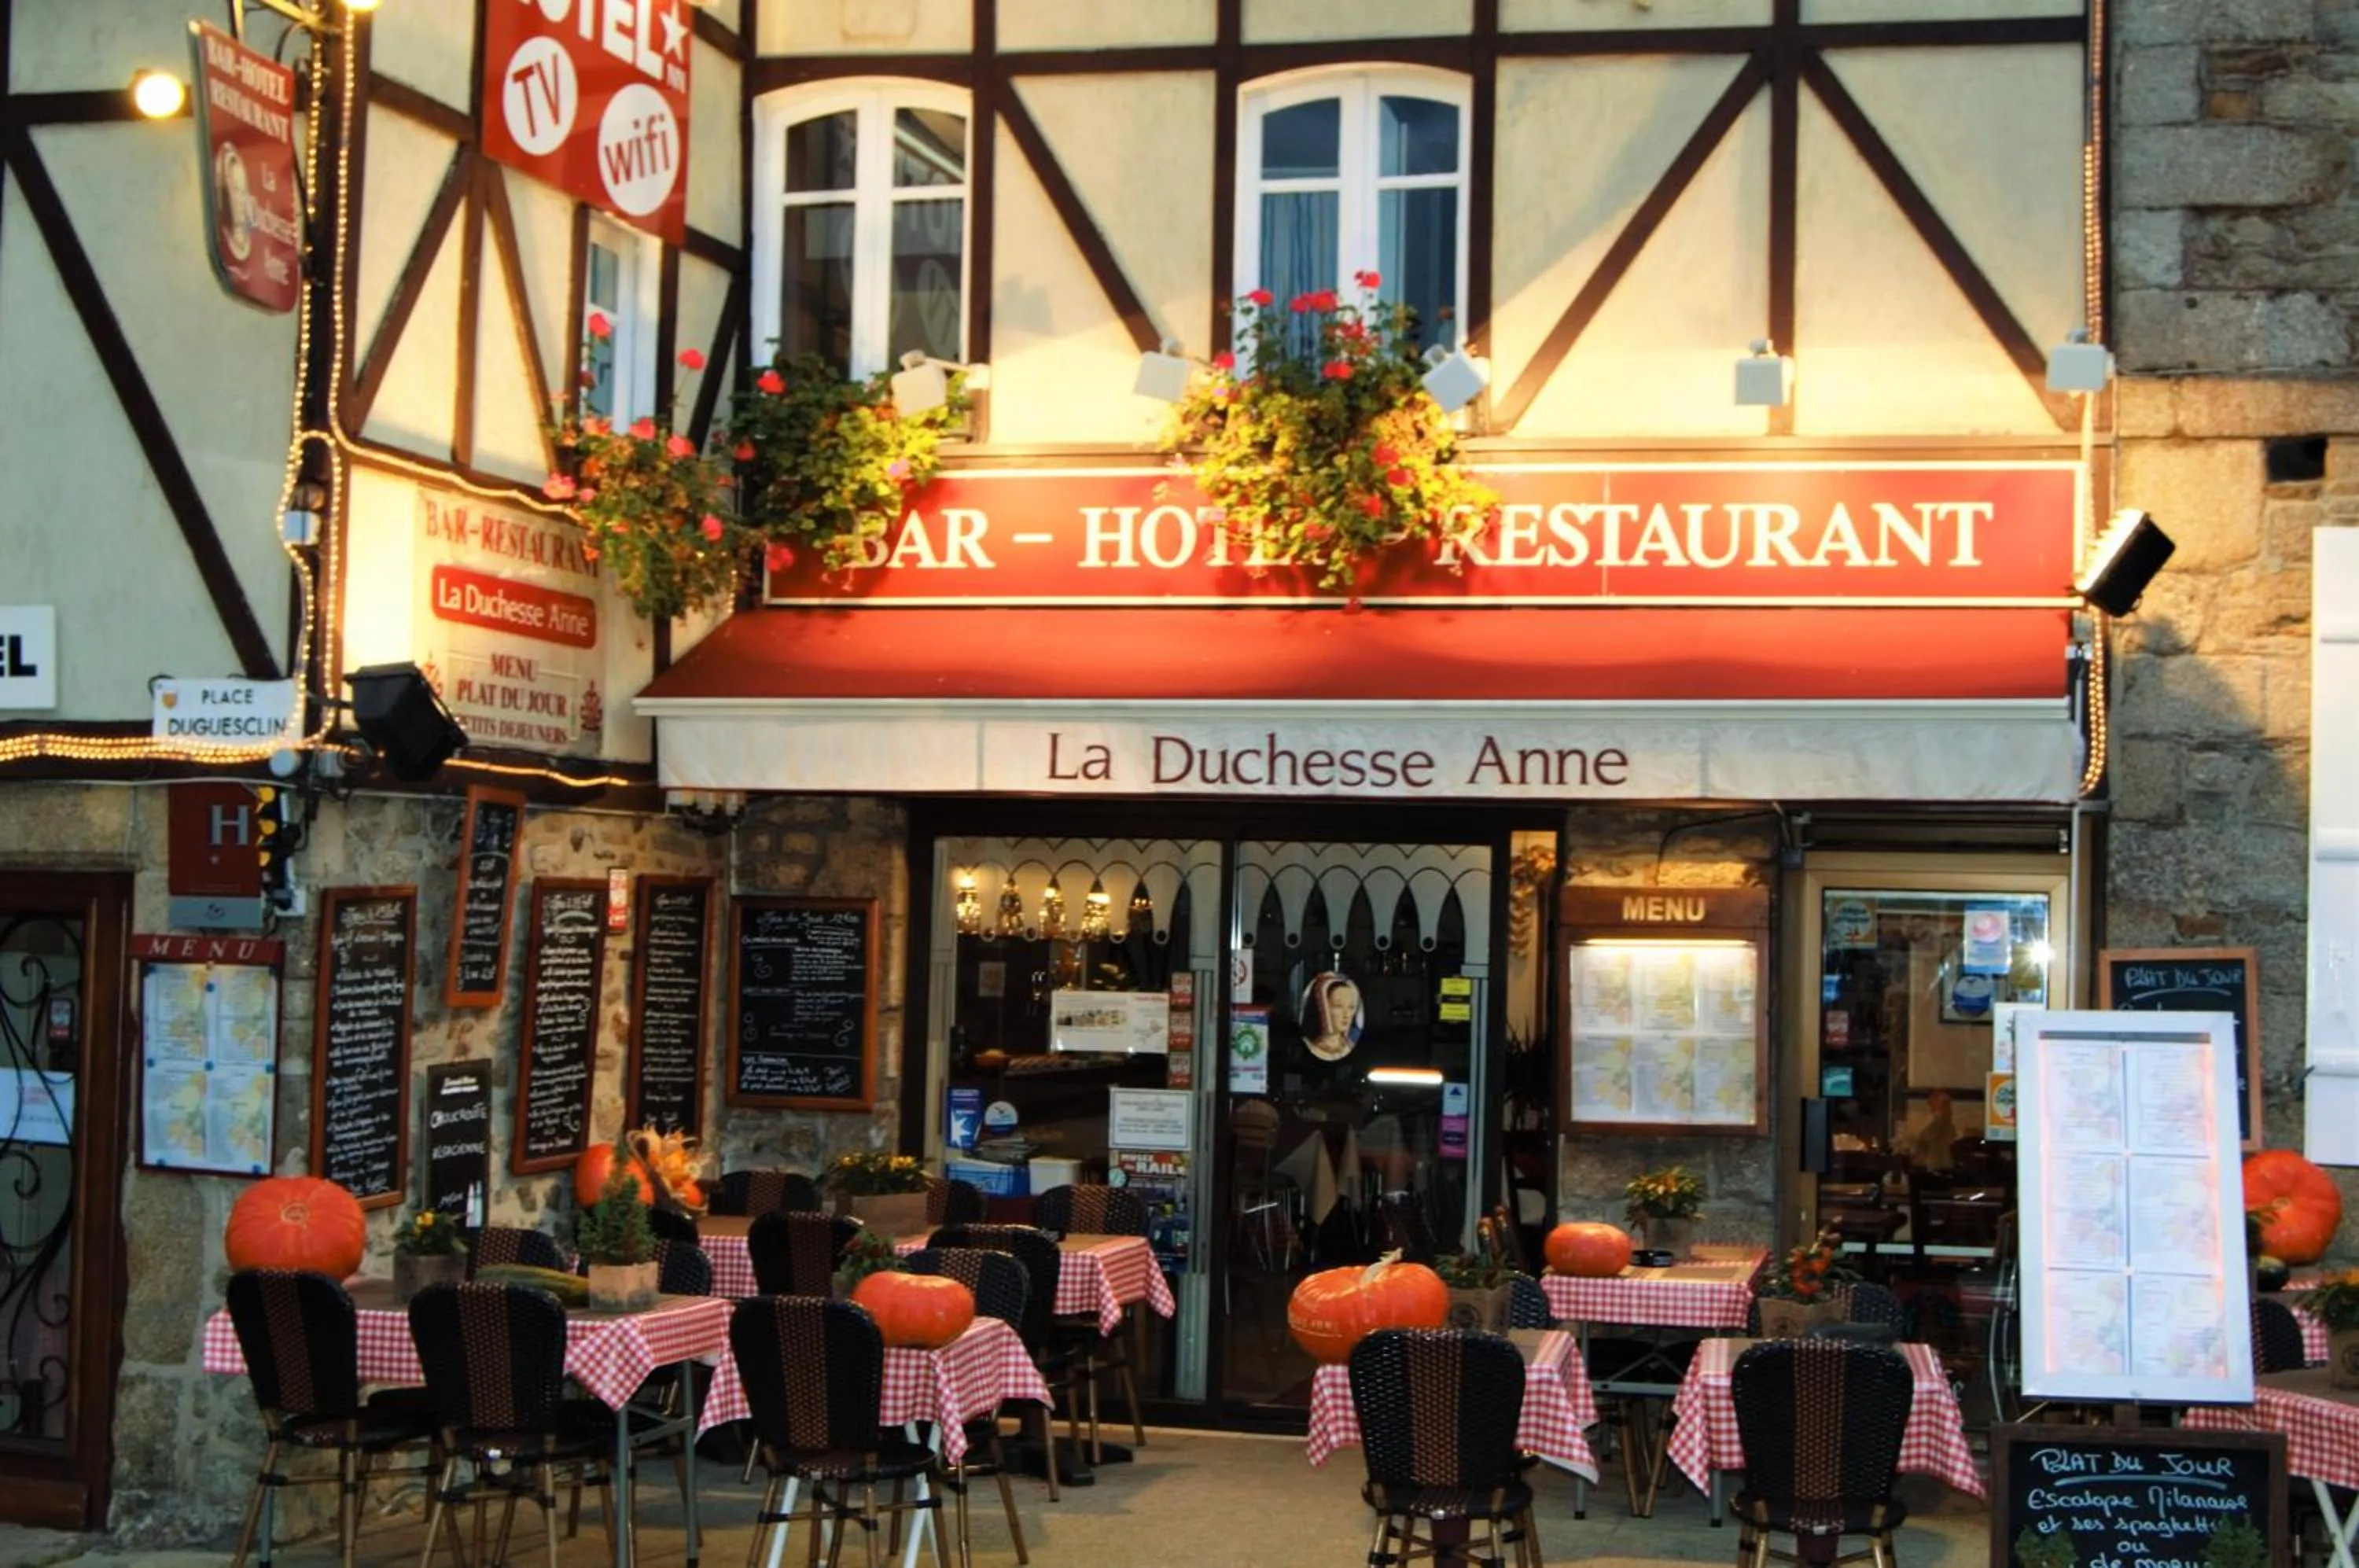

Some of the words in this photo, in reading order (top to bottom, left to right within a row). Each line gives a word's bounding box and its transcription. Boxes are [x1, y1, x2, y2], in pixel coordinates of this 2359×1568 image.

[513, 52, 559, 138] TV
[605, 113, 670, 186] wifi
[843, 507, 996, 569] BAR
[1076, 504, 1327, 569] HOTE
[1433, 502, 1994, 569] RESTAURANT
[440, 578, 462, 611] La
[465, 583, 545, 628] Duchesse
[548, 604, 588, 636] Anne
[0, 635, 37, 677] L
[491, 653, 538, 683] MENU
[202, 689, 254, 705] PLACE
[457, 679, 497, 706] PLAT
[500, 686, 524, 711] DU
[527, 690, 568, 718] JOUR
[168, 717, 286, 737] DUGUESCLIN
[1048, 732, 1111, 782] La
[1151, 732, 1434, 787] Duchesse
[1467, 735, 1628, 786] Anne
[211, 804, 248, 845] H
[1622, 896, 1706, 922] MENU
[149, 940, 255, 959] MENU
[2028, 1489, 2139, 1517] Escalope
[2037, 1515, 2063, 1533] et
[2071, 1516, 2106, 1530] ses
[2116, 1540, 2151, 1553] ou
